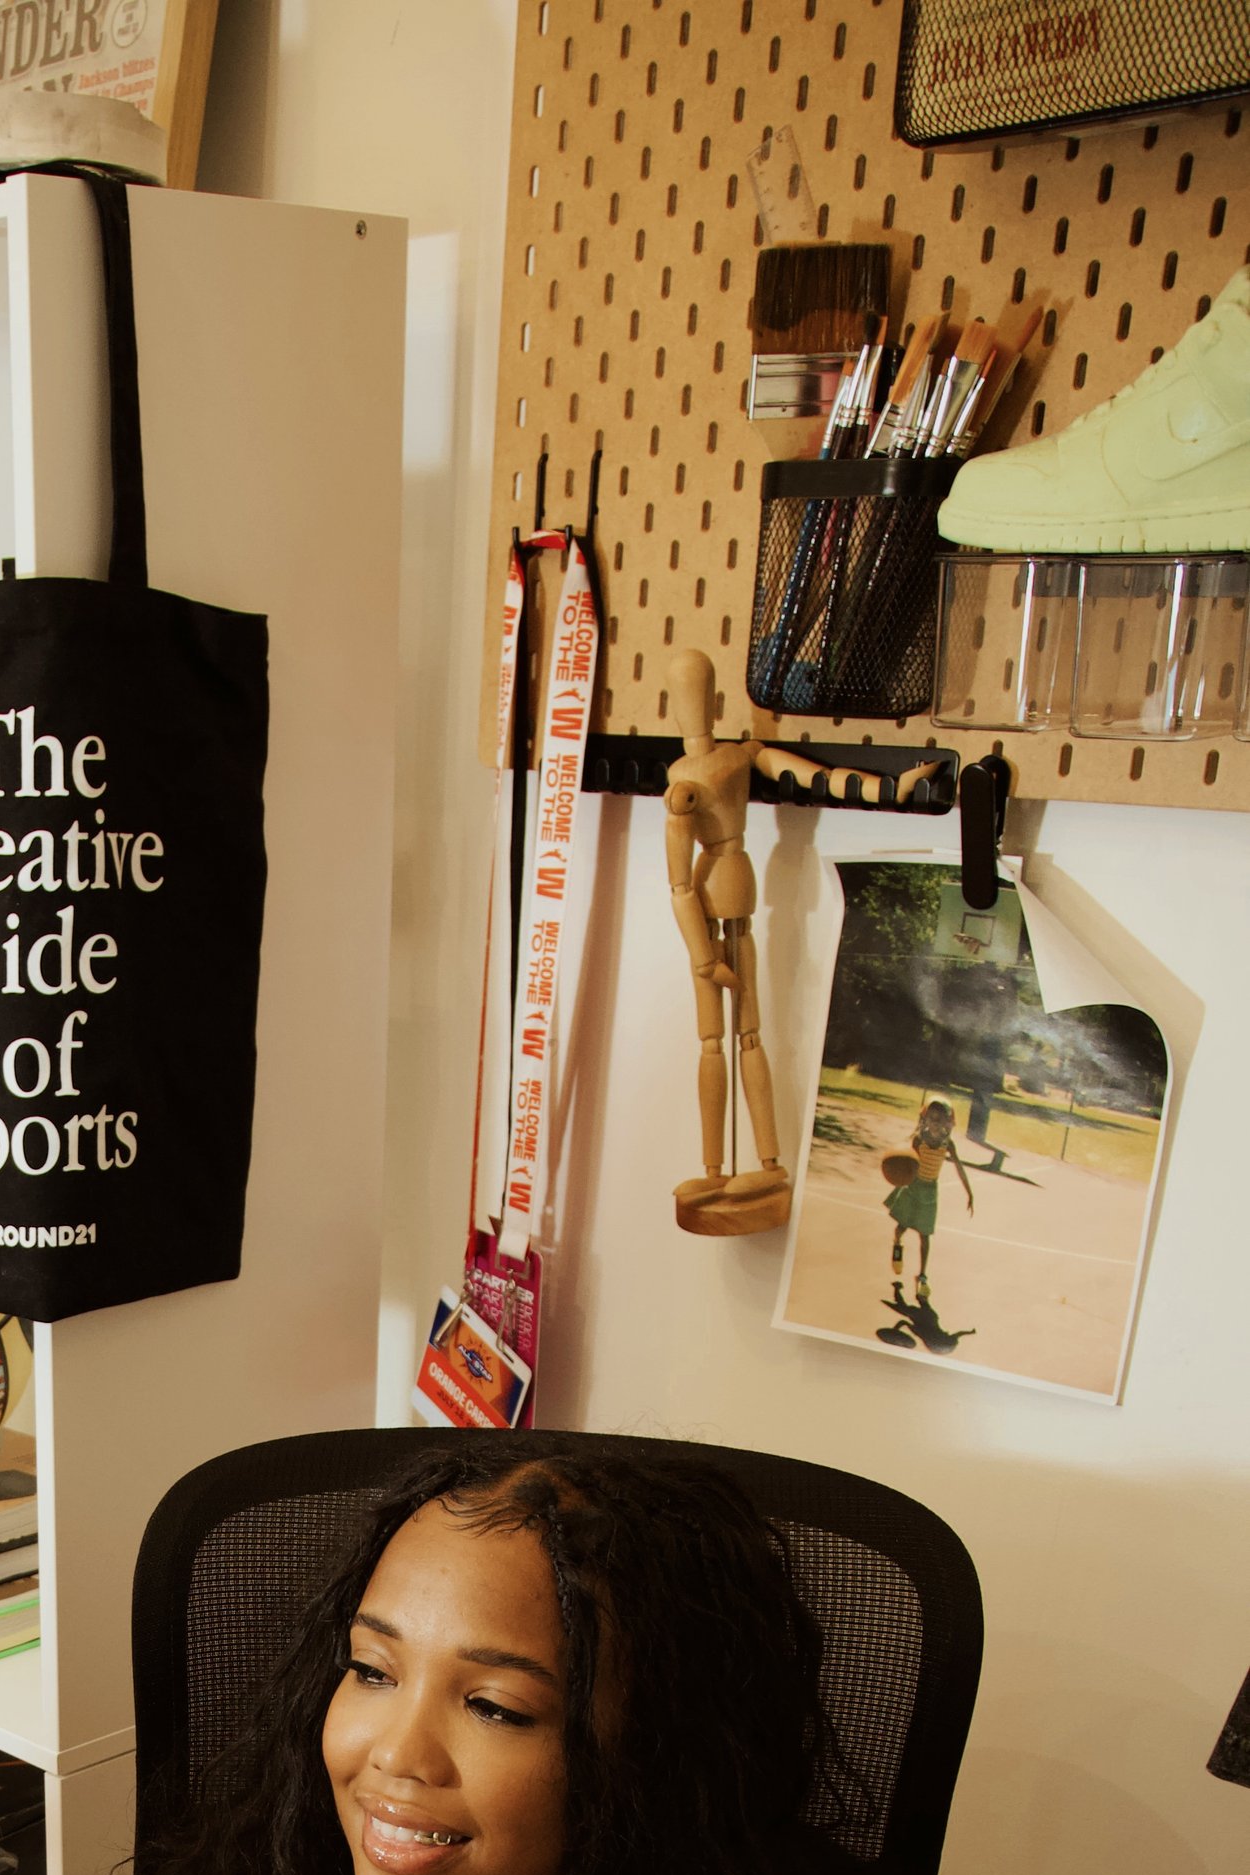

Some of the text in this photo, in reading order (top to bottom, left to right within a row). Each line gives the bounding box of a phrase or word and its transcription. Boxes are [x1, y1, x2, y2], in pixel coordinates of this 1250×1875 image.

[555, 591, 582, 682] TO THE
[571, 591, 598, 684] WELCOME
[541, 753, 561, 842] TO THE
[553, 753, 579, 844] WELCOME
[526, 919, 546, 1005] TO THE
[538, 920, 561, 1006] WELCOME
[1, 1009, 89, 1098] of
[513, 1078, 530, 1159] TO THE
[522, 1079, 543, 1163] WELCOME
[472, 1269, 535, 1305] PARTER
[429, 1361, 468, 1407] ORANGE
